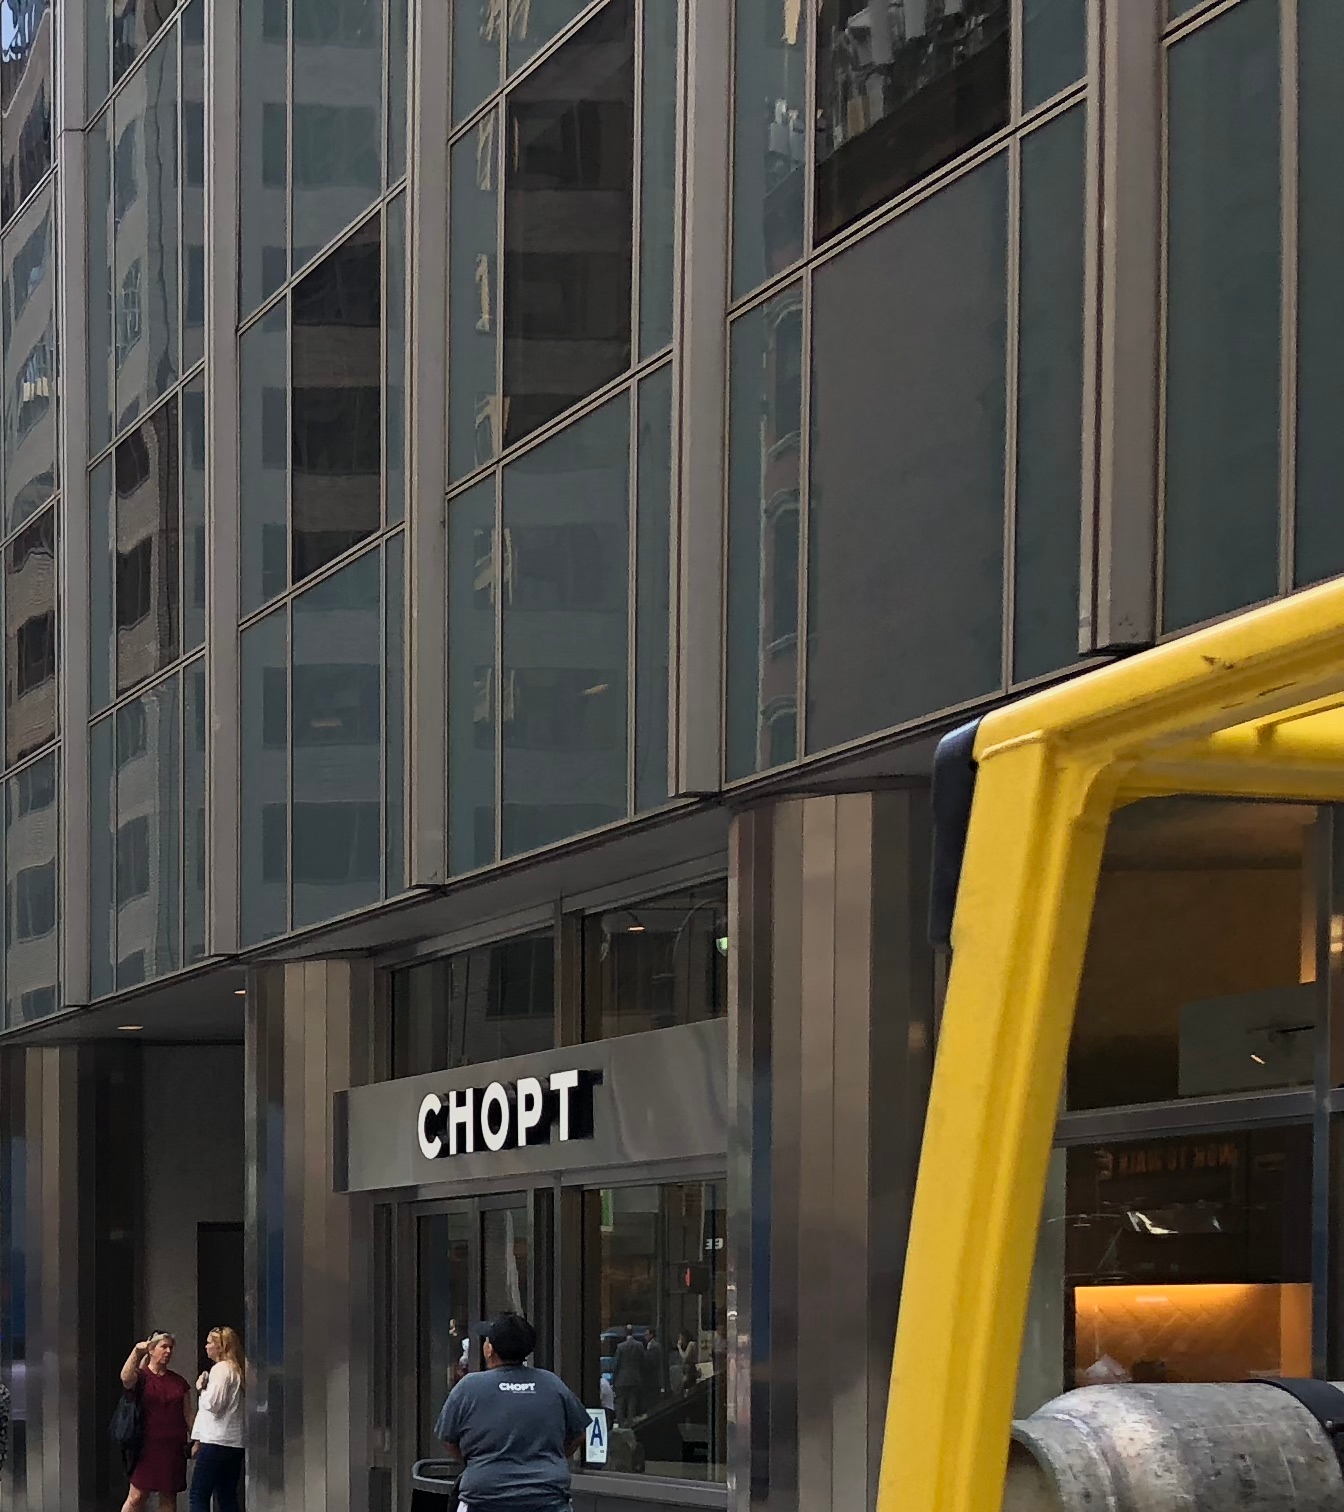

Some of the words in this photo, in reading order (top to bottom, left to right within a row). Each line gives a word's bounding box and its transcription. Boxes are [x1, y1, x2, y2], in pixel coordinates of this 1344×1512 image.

[417, 1069, 579, 1160] CHOPT
[498, 1382, 536, 1392] CHOPT
[589, 1416, 604, 1447] A
